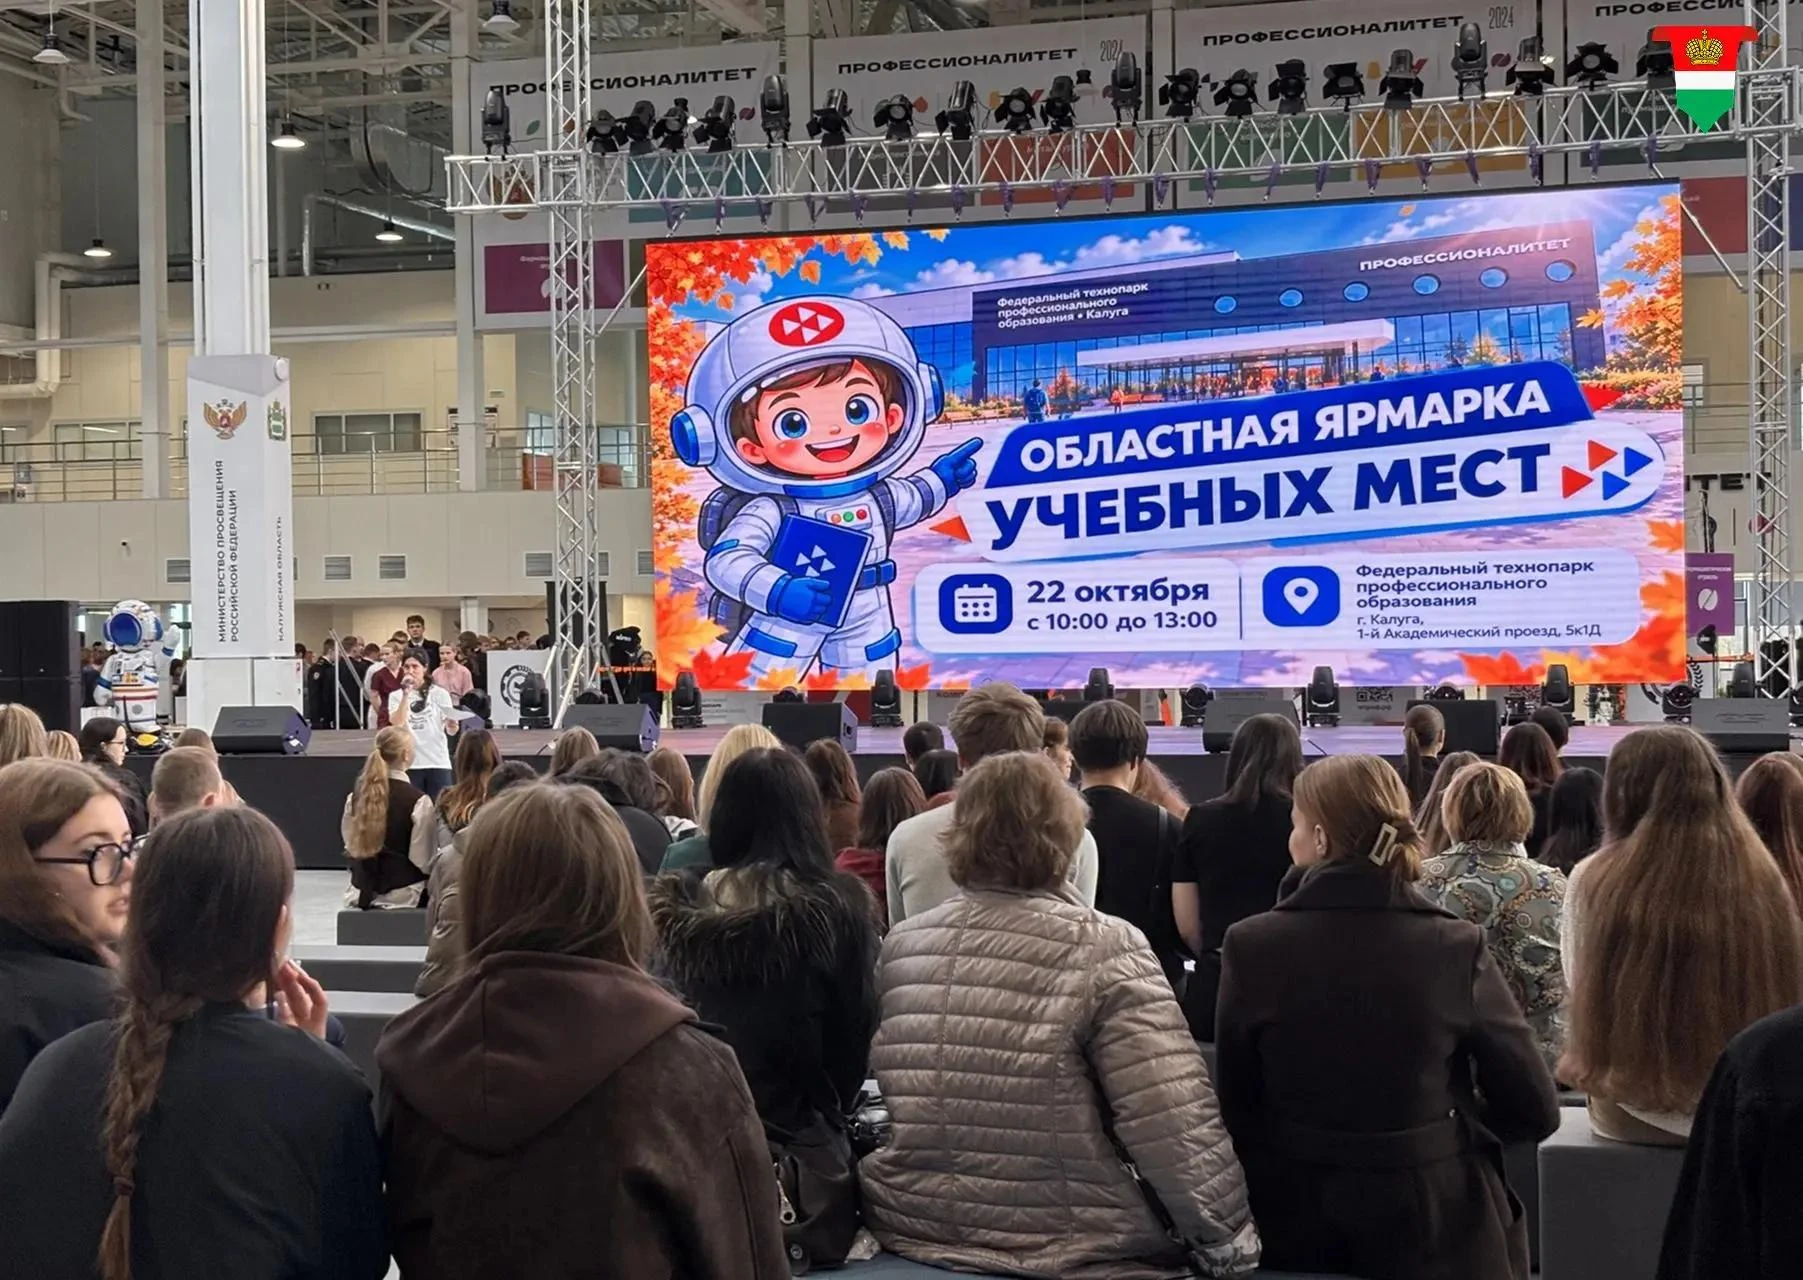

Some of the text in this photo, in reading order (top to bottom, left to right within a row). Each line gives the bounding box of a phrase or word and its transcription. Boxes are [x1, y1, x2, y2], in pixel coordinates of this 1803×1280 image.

[1488, 6, 1514, 29] 2024
[1203, 16, 1463, 46] ПРОФЕССИОНАЛИТЕТ
[838, 48, 1077, 74] ПРОФЕССИОНАЛИТЕТ
[1359, 238, 1571, 271] ПРОФЕССИОНАЛИТЕТ
[997, 282, 1149, 307] Федеральный технопарк
[998, 297, 1118, 319] профессионального
[998, 307, 1129, 329] образования Калуга
[1020, 379, 1551, 473] ОБЛАСТНАЯ ЯРМАРКА
[985, 443, 1551, 551] УЧЕБНЫХ МЕСТ
[215, 460, 226, 642] МИНИСТЕРСТВО ПРОСВЕЩЕНИЯ
[228, 489, 239, 642] РОССИЙСКОЙ ФЕДЕРАЦИИ
[1356, 560, 1594, 579] Федеральный технопарк
[1027, 577, 1209, 606] 22 октября
[1356, 577, 1547, 593] профессионального
[1356, 595, 1477, 610] образования
[1027, 611, 1217, 632] с 10:00 до 13:00
[1357, 613, 1424, 628] г. Калуга,
[1357, 624, 1601, 640] 1-й Академический проезд, 5к1Д
